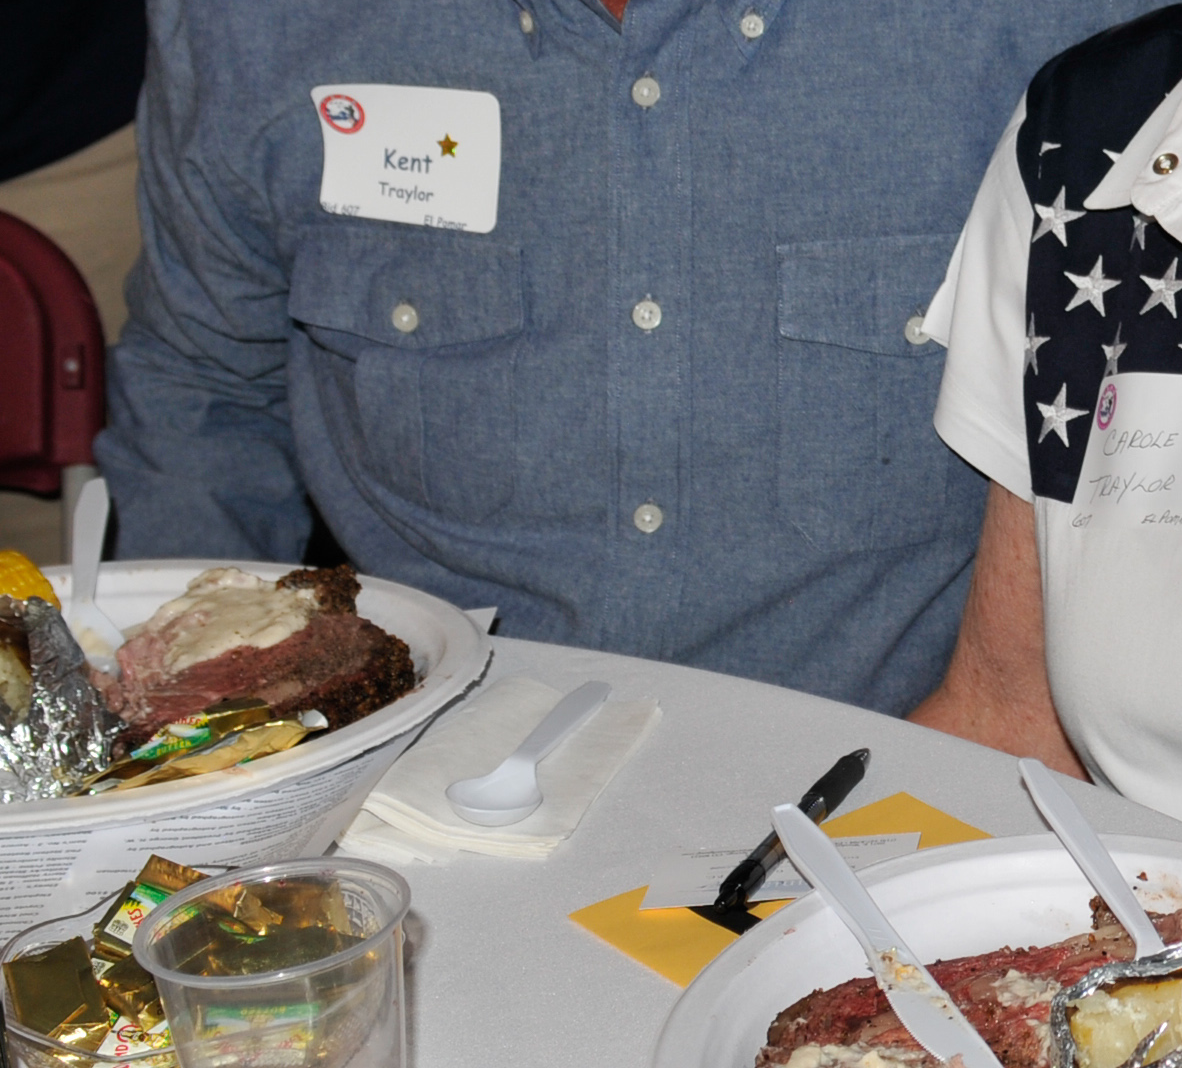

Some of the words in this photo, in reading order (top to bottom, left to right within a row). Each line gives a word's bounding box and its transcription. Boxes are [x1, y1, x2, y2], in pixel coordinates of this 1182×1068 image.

[383, 147, 433, 175] Kent
[378, 180, 435, 205] Traylor
[436, 216, 468, 232] Pomar
[1102, 429, 1180, 457] CAROLE
[1088, 472, 1177, 505] TRAYLOR
